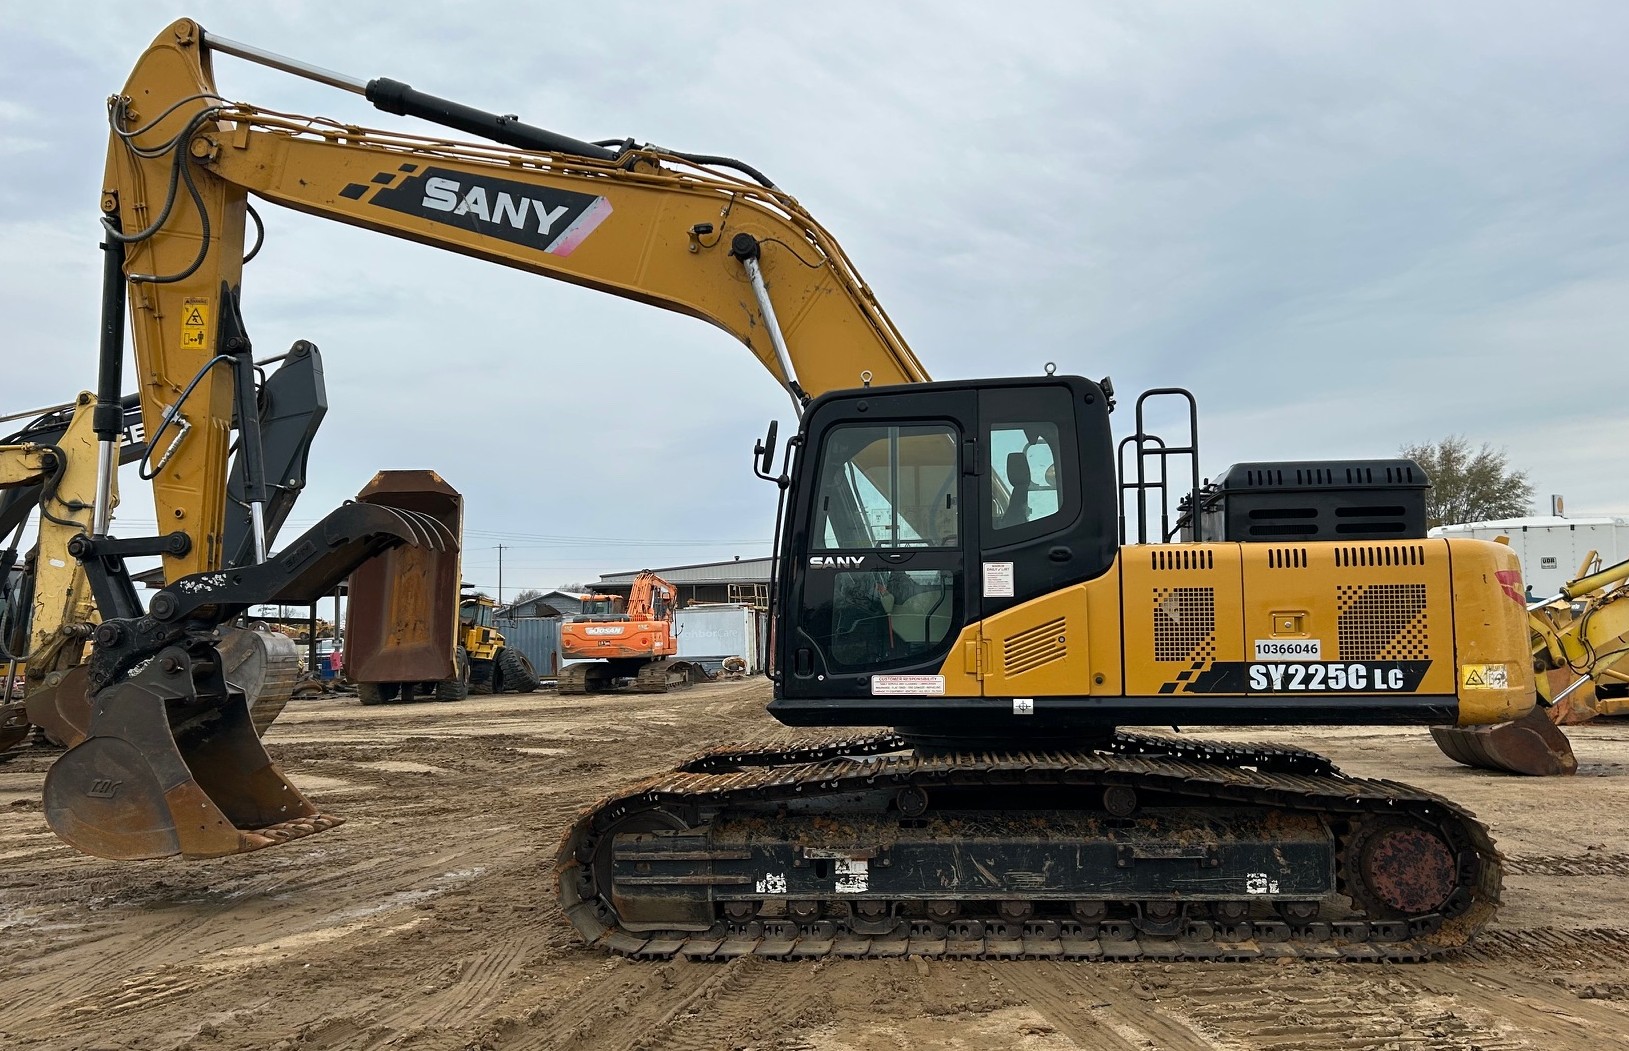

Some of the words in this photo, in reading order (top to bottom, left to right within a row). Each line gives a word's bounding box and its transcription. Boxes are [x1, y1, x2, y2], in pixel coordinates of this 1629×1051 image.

[422, 177, 569, 236] SANY
[809, 556, 866, 570] SANY
[1255, 643, 1318, 655] 10366046
[1249, 663, 1367, 691] SY225C
[1373, 668, 1404, 690] LC
